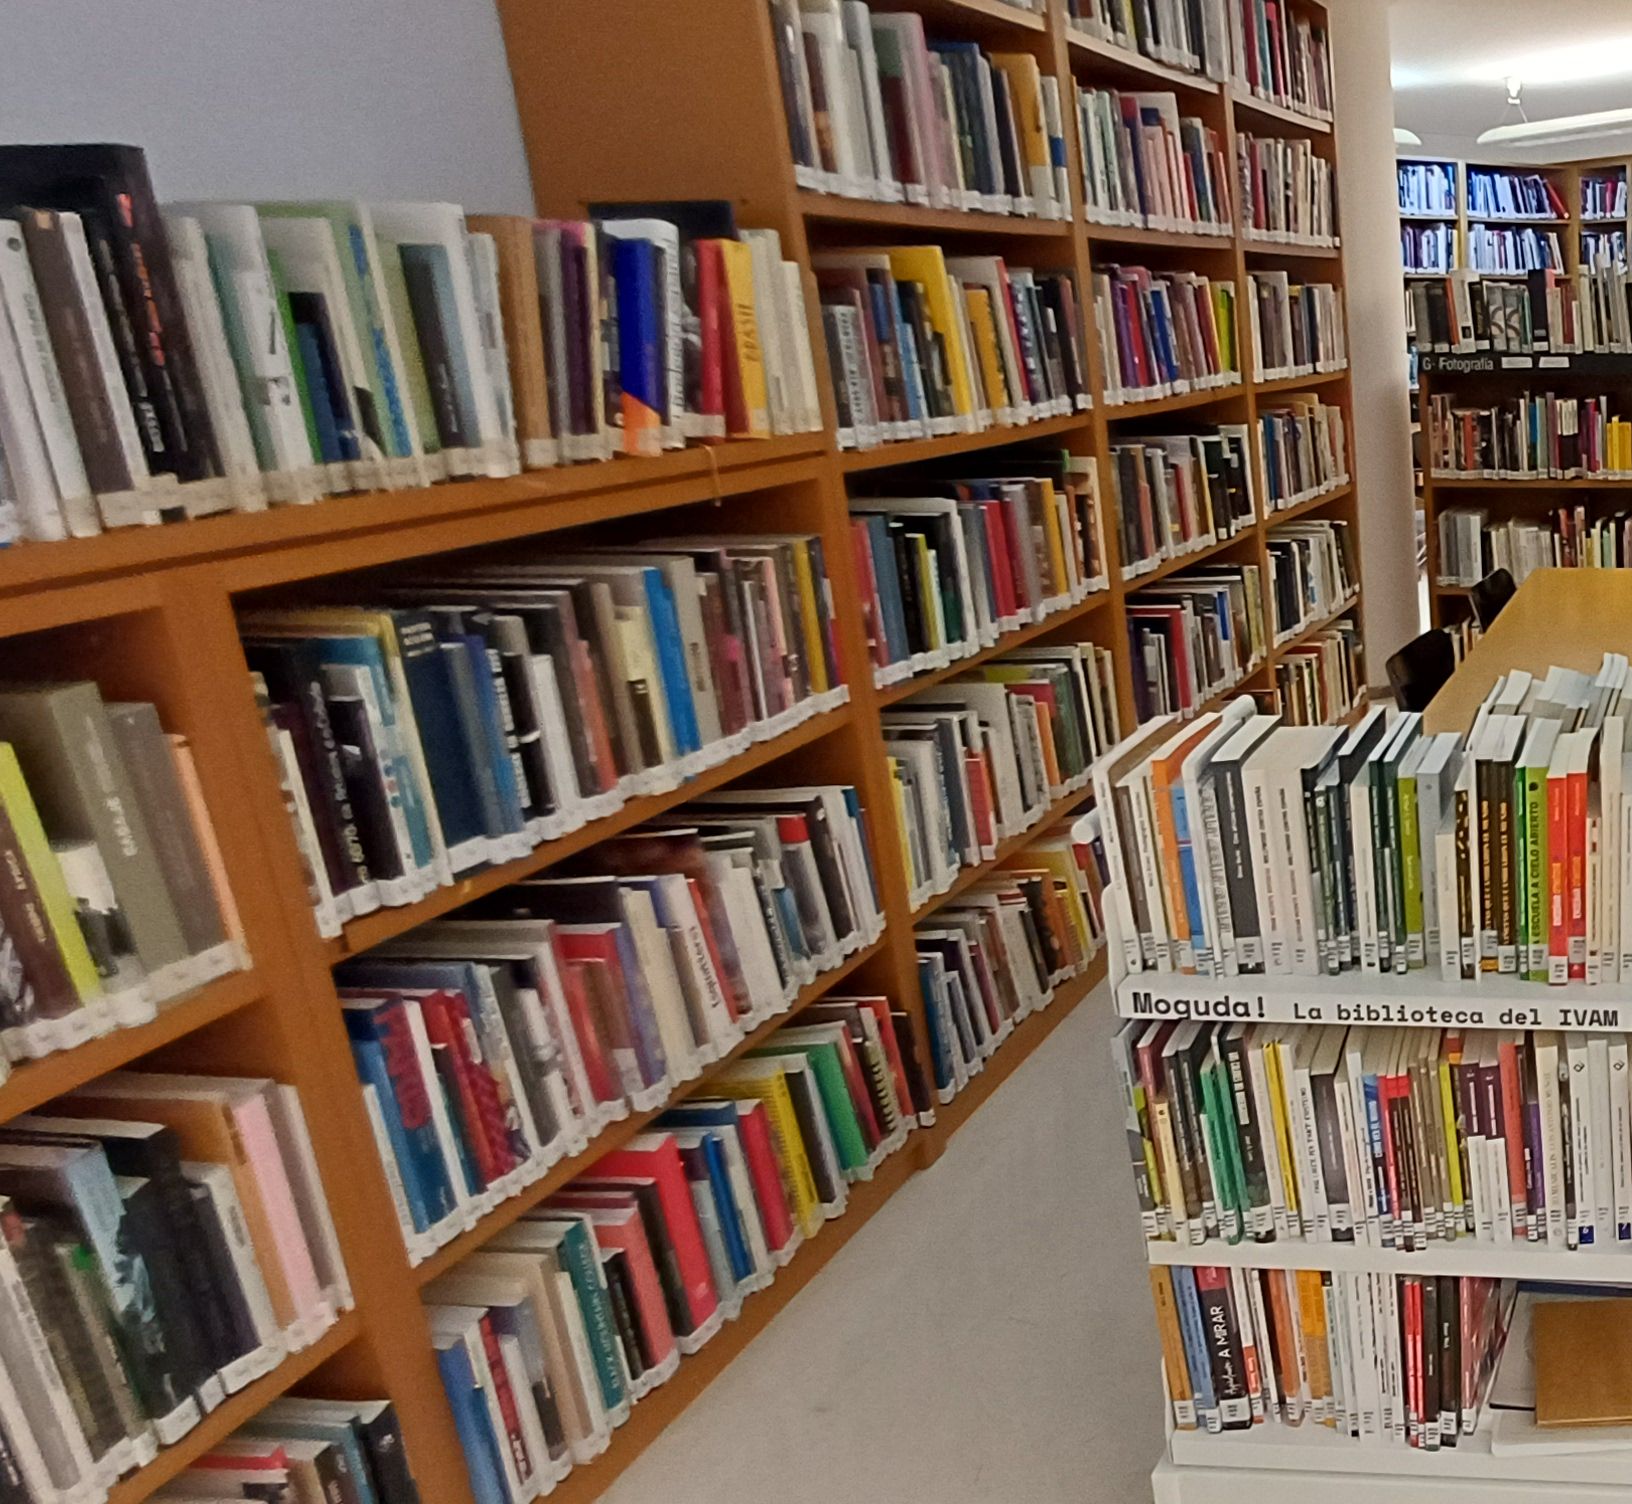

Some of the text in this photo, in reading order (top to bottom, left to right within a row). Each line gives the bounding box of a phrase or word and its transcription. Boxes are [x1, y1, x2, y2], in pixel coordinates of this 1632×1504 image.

[1529, 802, 1539, 847] ABIERTO
[1530, 849, 1539, 879] CIELO
[1530, 882, 1539, 892] A
[1530, 892, 1540, 938] ESCUELA
[1132, 991, 1265, 1019] Moguda!
[1293, 1002, 1322, 1020] La
[1336, 1003, 1484, 1024] biblioteca
[1499, 1008, 1541, 1026] del
[1559, 1009, 1618, 1027] IVAM
